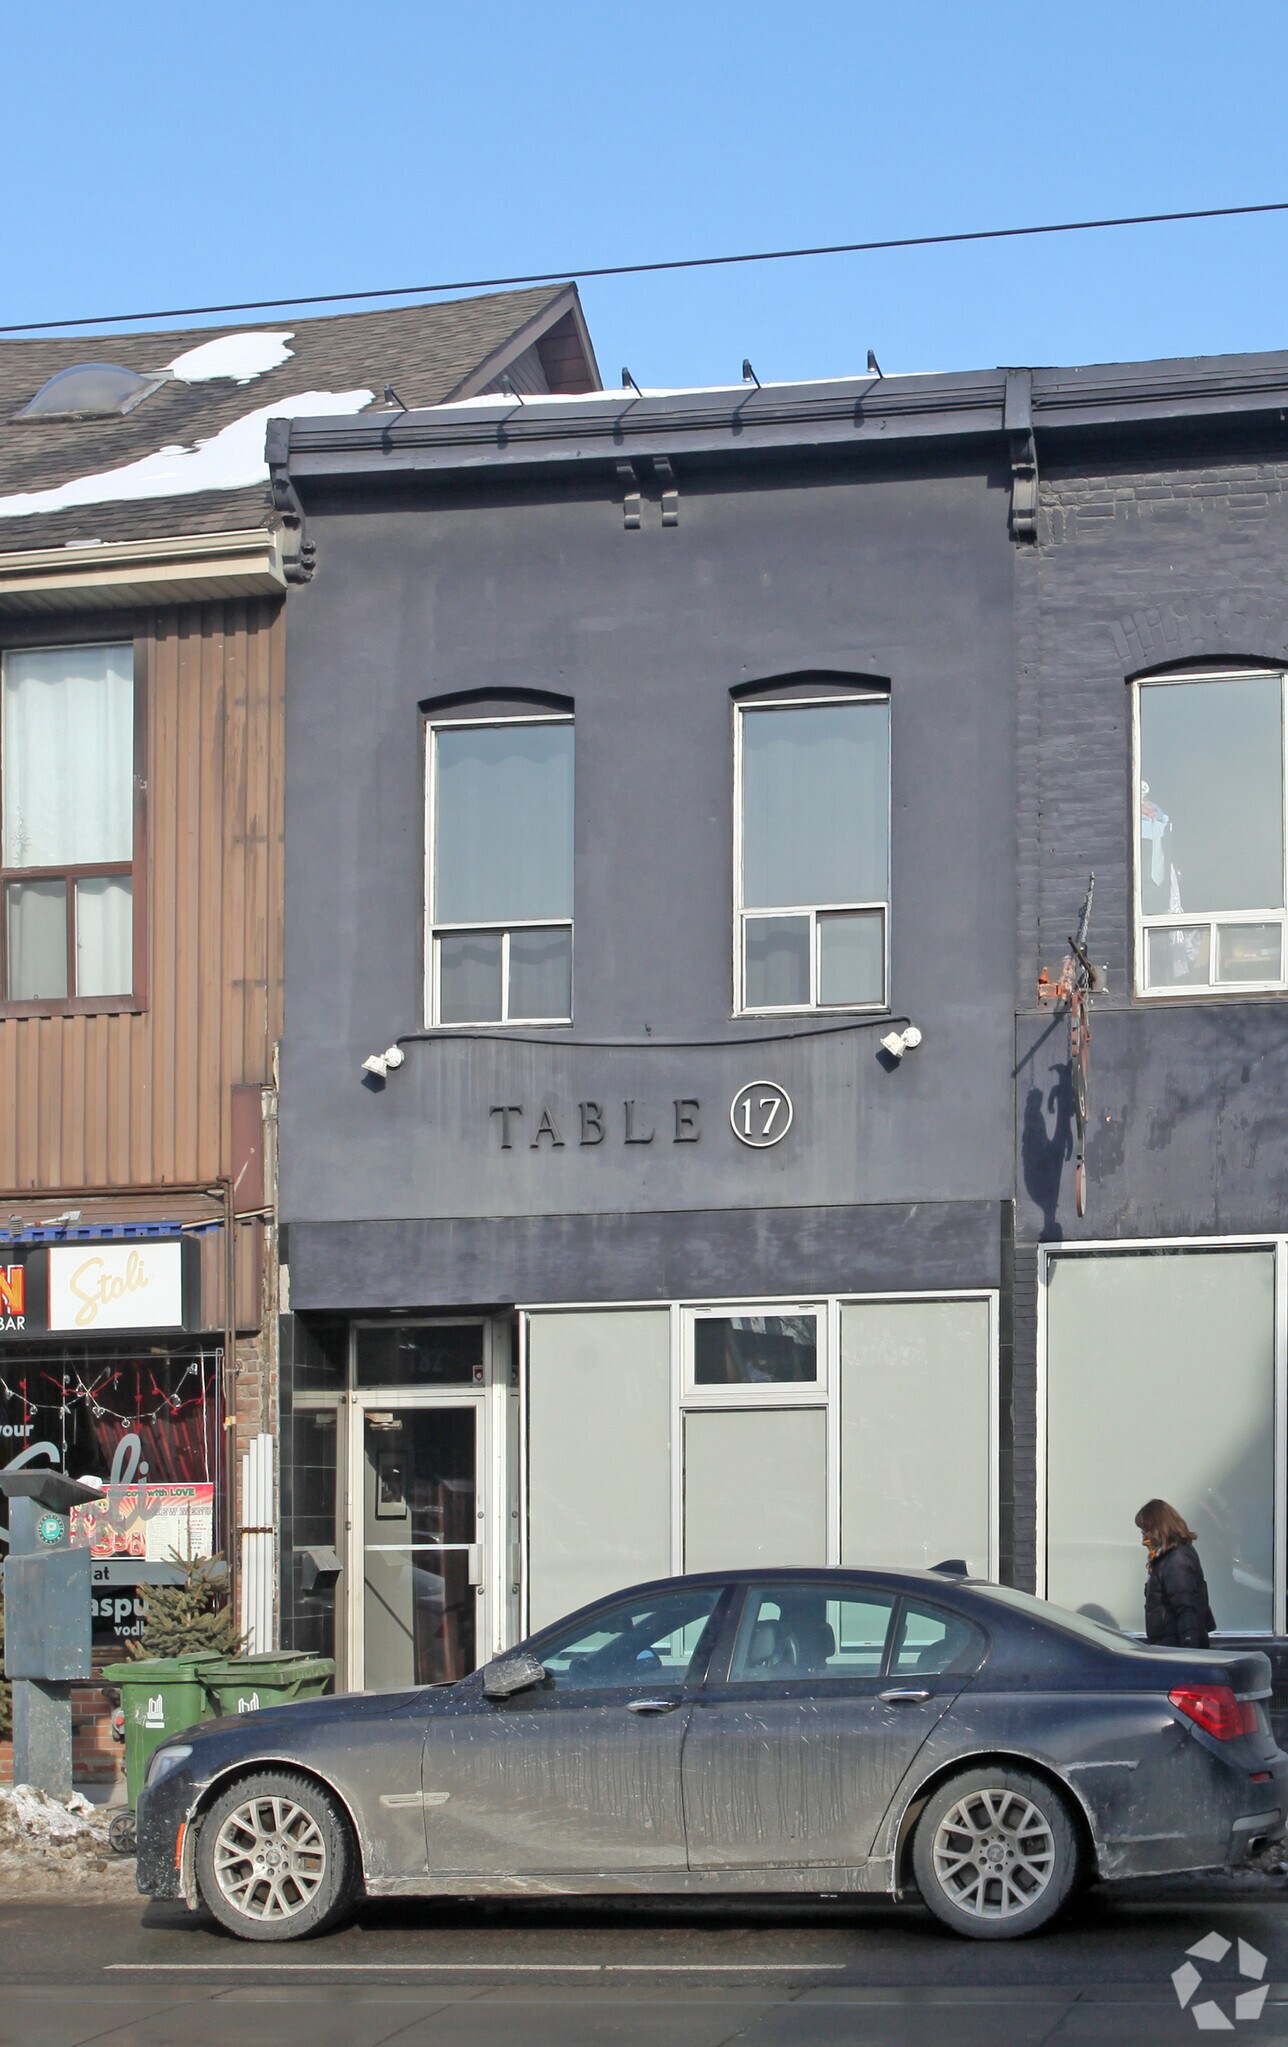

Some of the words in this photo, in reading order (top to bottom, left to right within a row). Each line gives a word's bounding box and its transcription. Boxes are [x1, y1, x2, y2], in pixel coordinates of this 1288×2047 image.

[489, 1098, 700, 1149] TABLE
[741, 1098, 781, 1135] 17
[69, 1250, 154, 1326] Stoli
[170, 1488, 195, 1496] LOVE
[93, 1567, 109, 1580] at
